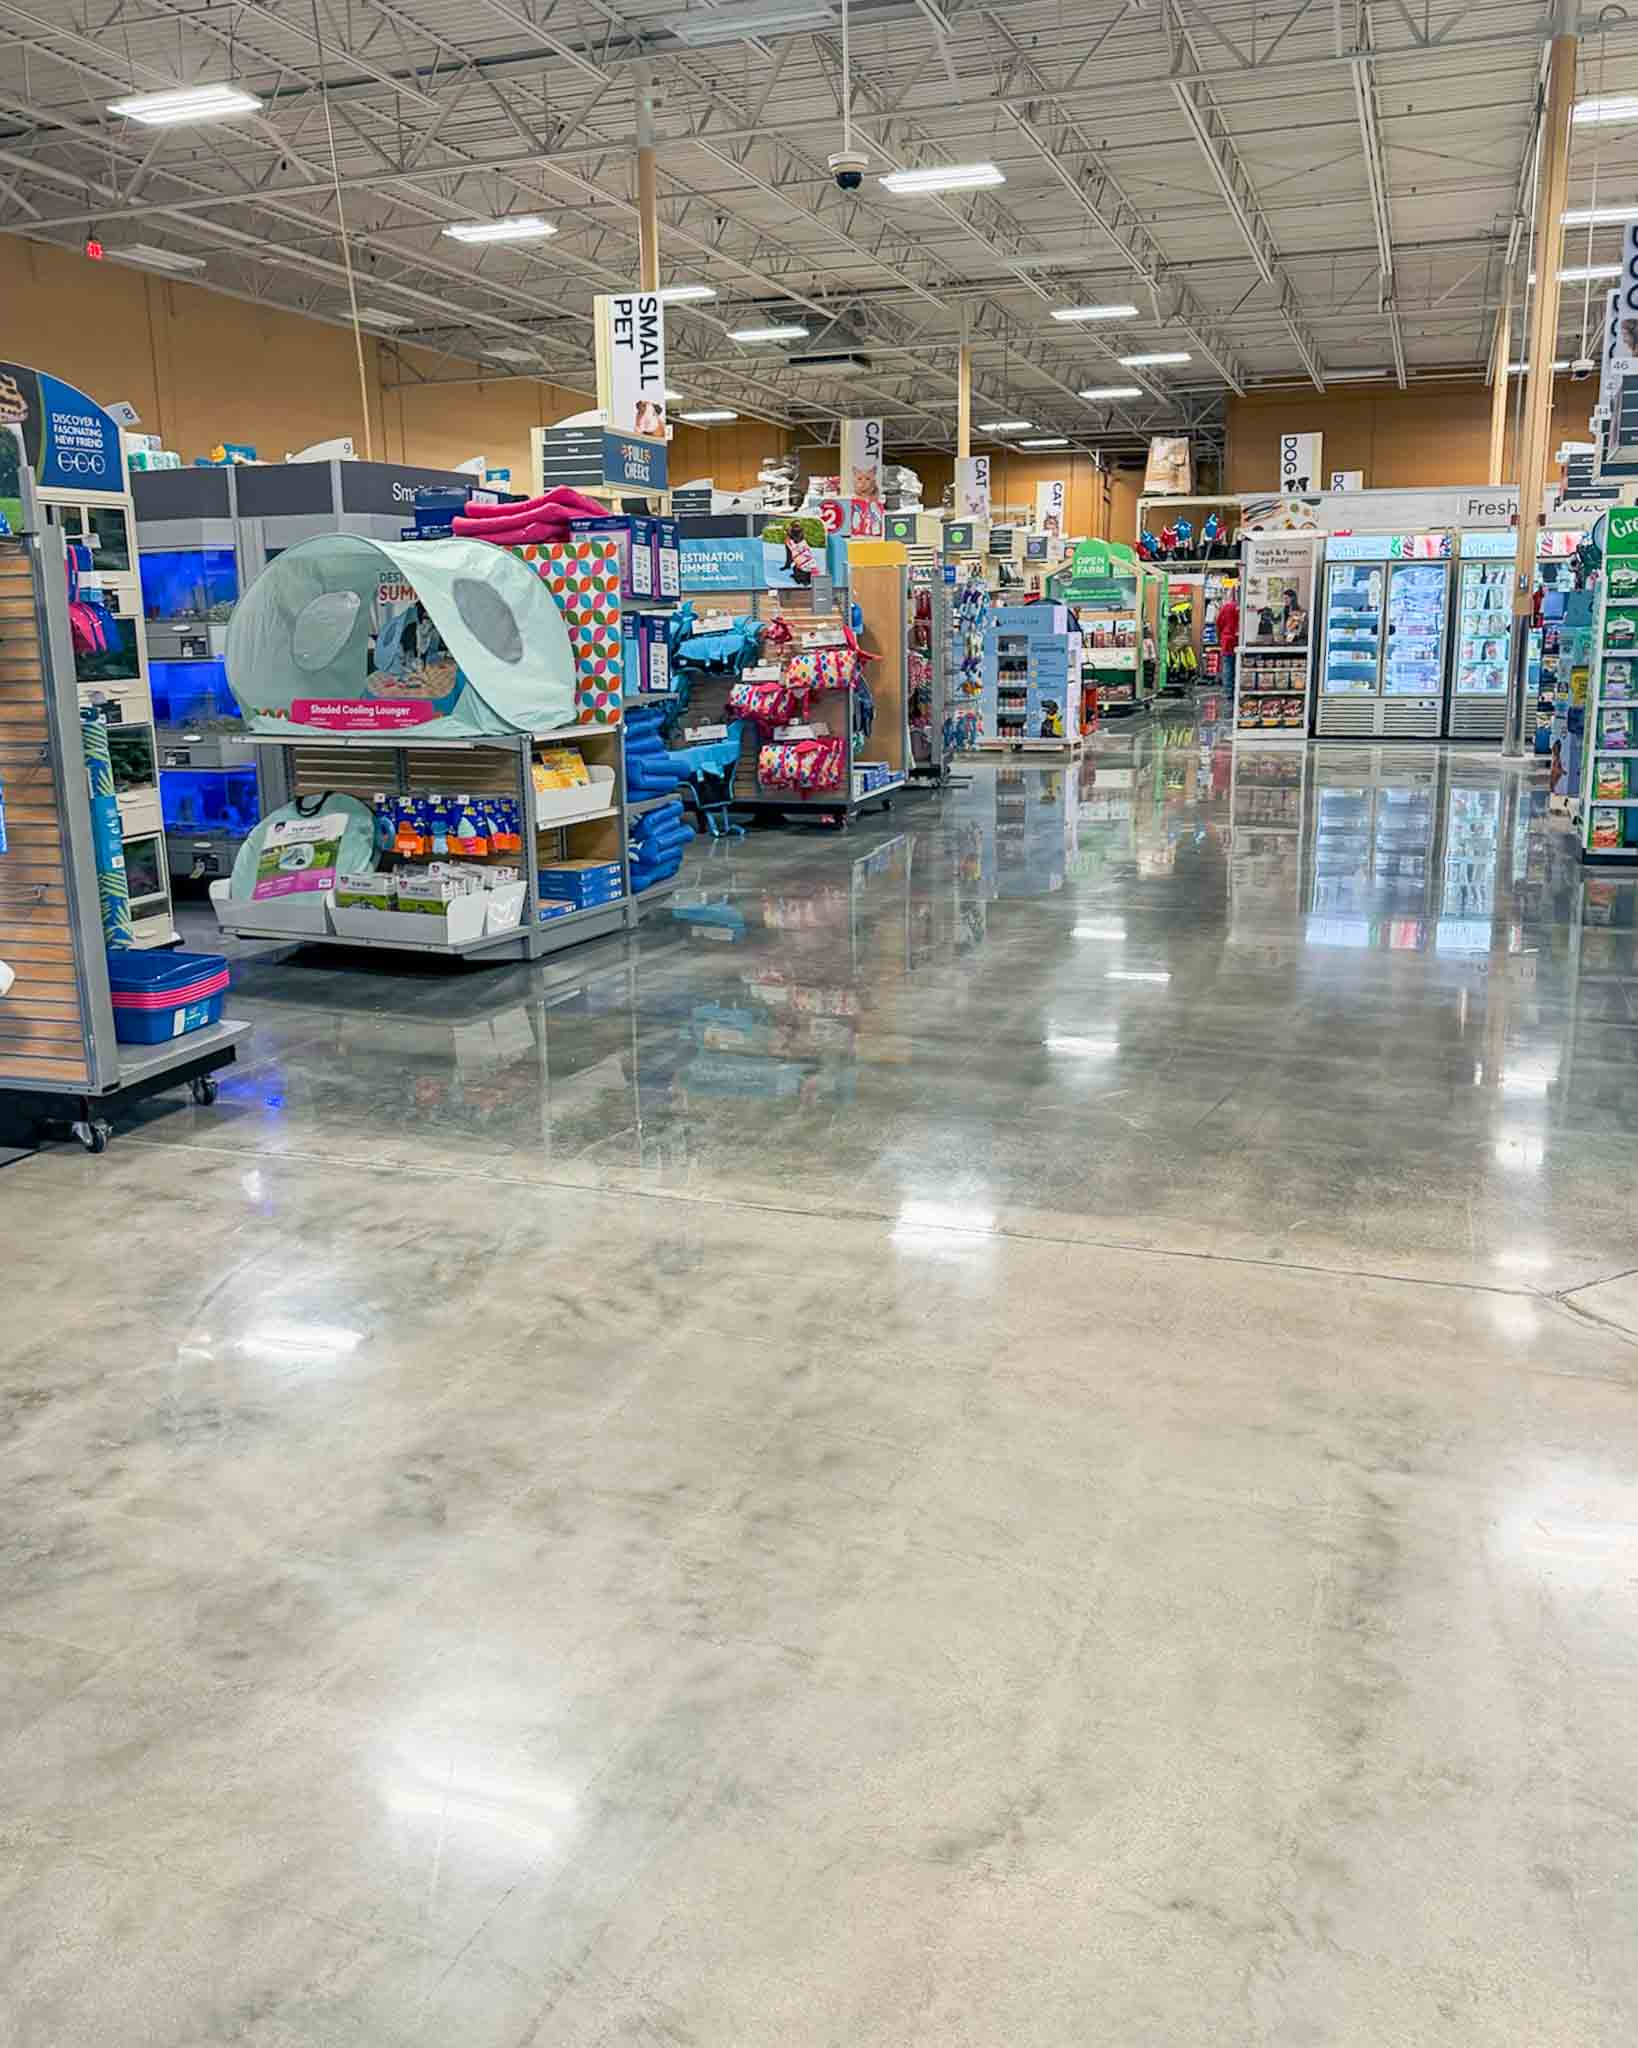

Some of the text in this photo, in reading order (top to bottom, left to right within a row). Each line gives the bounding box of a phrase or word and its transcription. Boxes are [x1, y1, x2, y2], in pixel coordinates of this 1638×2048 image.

[613, 298, 635, 352] PET
[638, 296, 660, 391] SMALL
[1613, 360, 1629, 370] 46
[52, 412, 94, 427] DISCOVER
[53, 423, 103, 439] FASCINATING
[55, 434, 104, 449] NEW FRIEND
[343, 442, 351, 454] 9
[864, 421, 880, 460] CAT
[1283, 436, 1298, 475] DOG
[624, 462, 650, 482] CHEEKS
[975, 458, 988, 489] CAT
[1332, 474, 1345, 492] DO
[1052, 482, 1064, 508] CAT
[1467, 499, 1518, 517] Fresh
[680, 551, 745, 562] ESTINATION
[1076, 556, 1105, 566] OPEN
[680, 562, 720, 573] UMMER
[1076, 565, 1105, 575] FARM
[379, 585, 418, 601] SUM
[311, 704, 411, 717] Shaded Cooling Lounger
